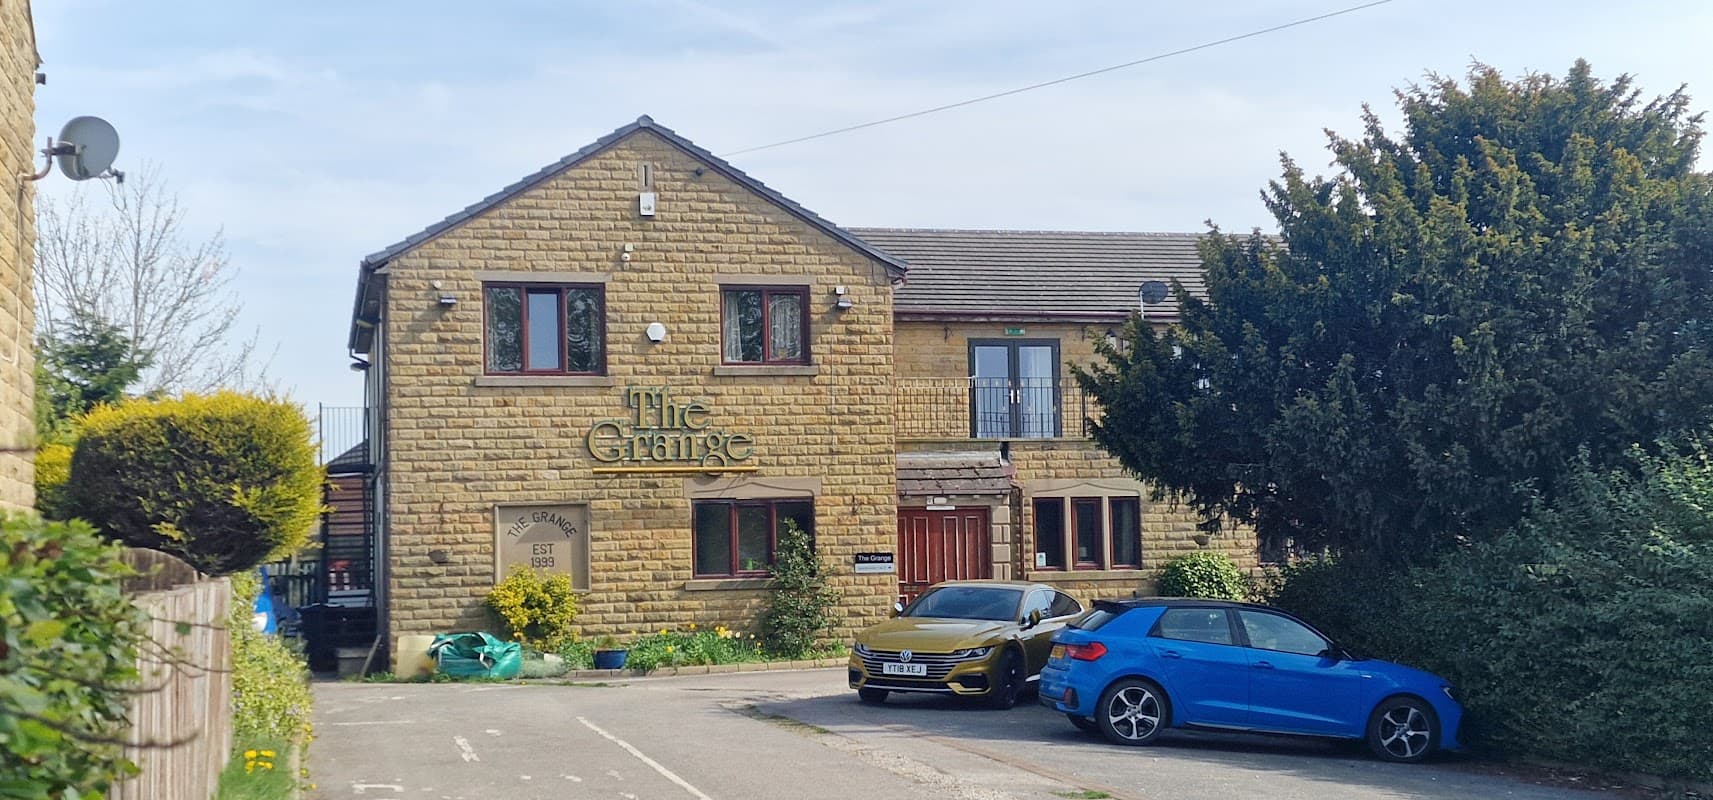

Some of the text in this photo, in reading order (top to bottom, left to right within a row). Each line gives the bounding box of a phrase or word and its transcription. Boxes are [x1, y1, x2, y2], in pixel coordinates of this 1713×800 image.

[629, 385, 712, 429] The
[588, 420, 753, 476] Grange
[507, 511, 577, 538] THE GRANGE
[532, 543, 554, 555] EST
[531, 557, 555, 568] 1999
[906, 664, 922, 673] XEJ
